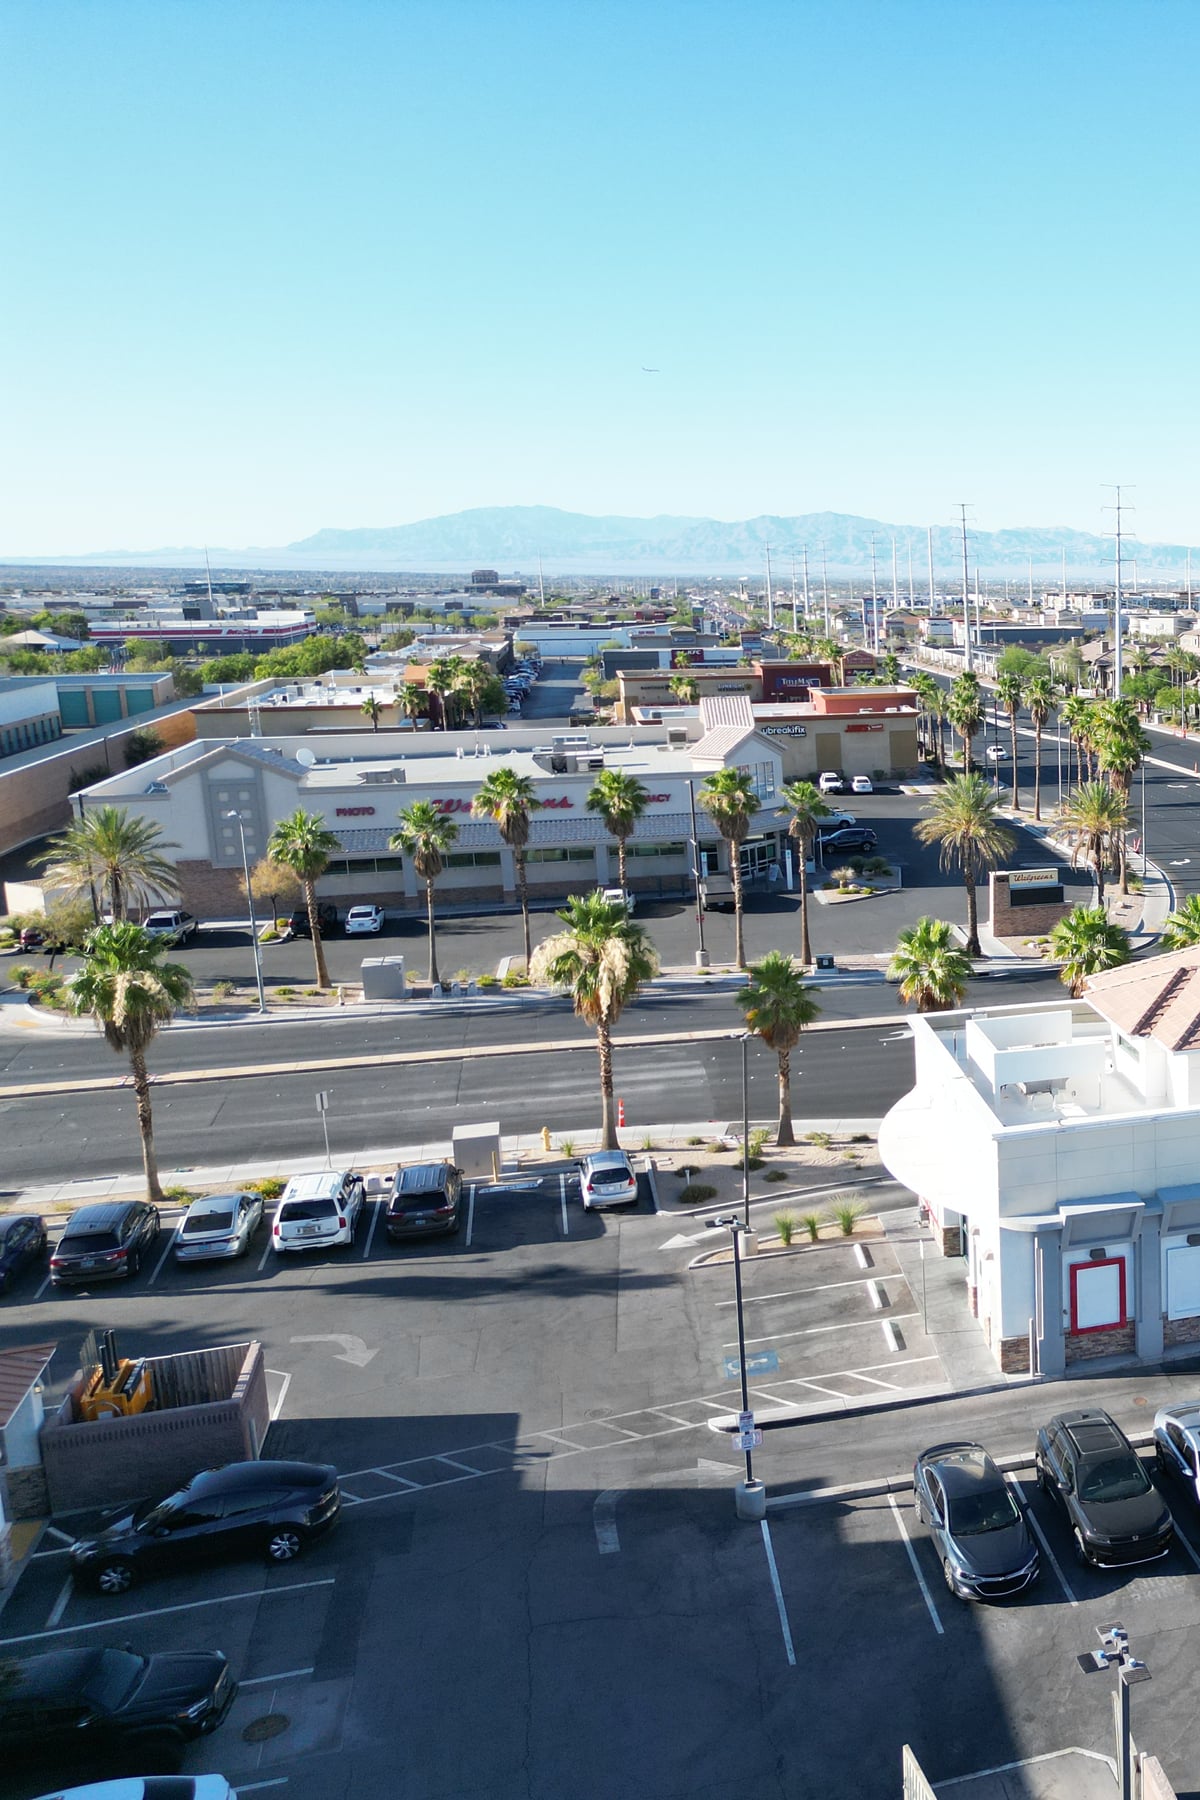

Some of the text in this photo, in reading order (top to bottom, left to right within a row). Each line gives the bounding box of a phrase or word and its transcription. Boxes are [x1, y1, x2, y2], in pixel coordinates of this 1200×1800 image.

[762, 725, 805, 735] ubreakifix
[335, 806, 375, 817] PHOTO
[1013, 874, 1055, 883] Walgreens
